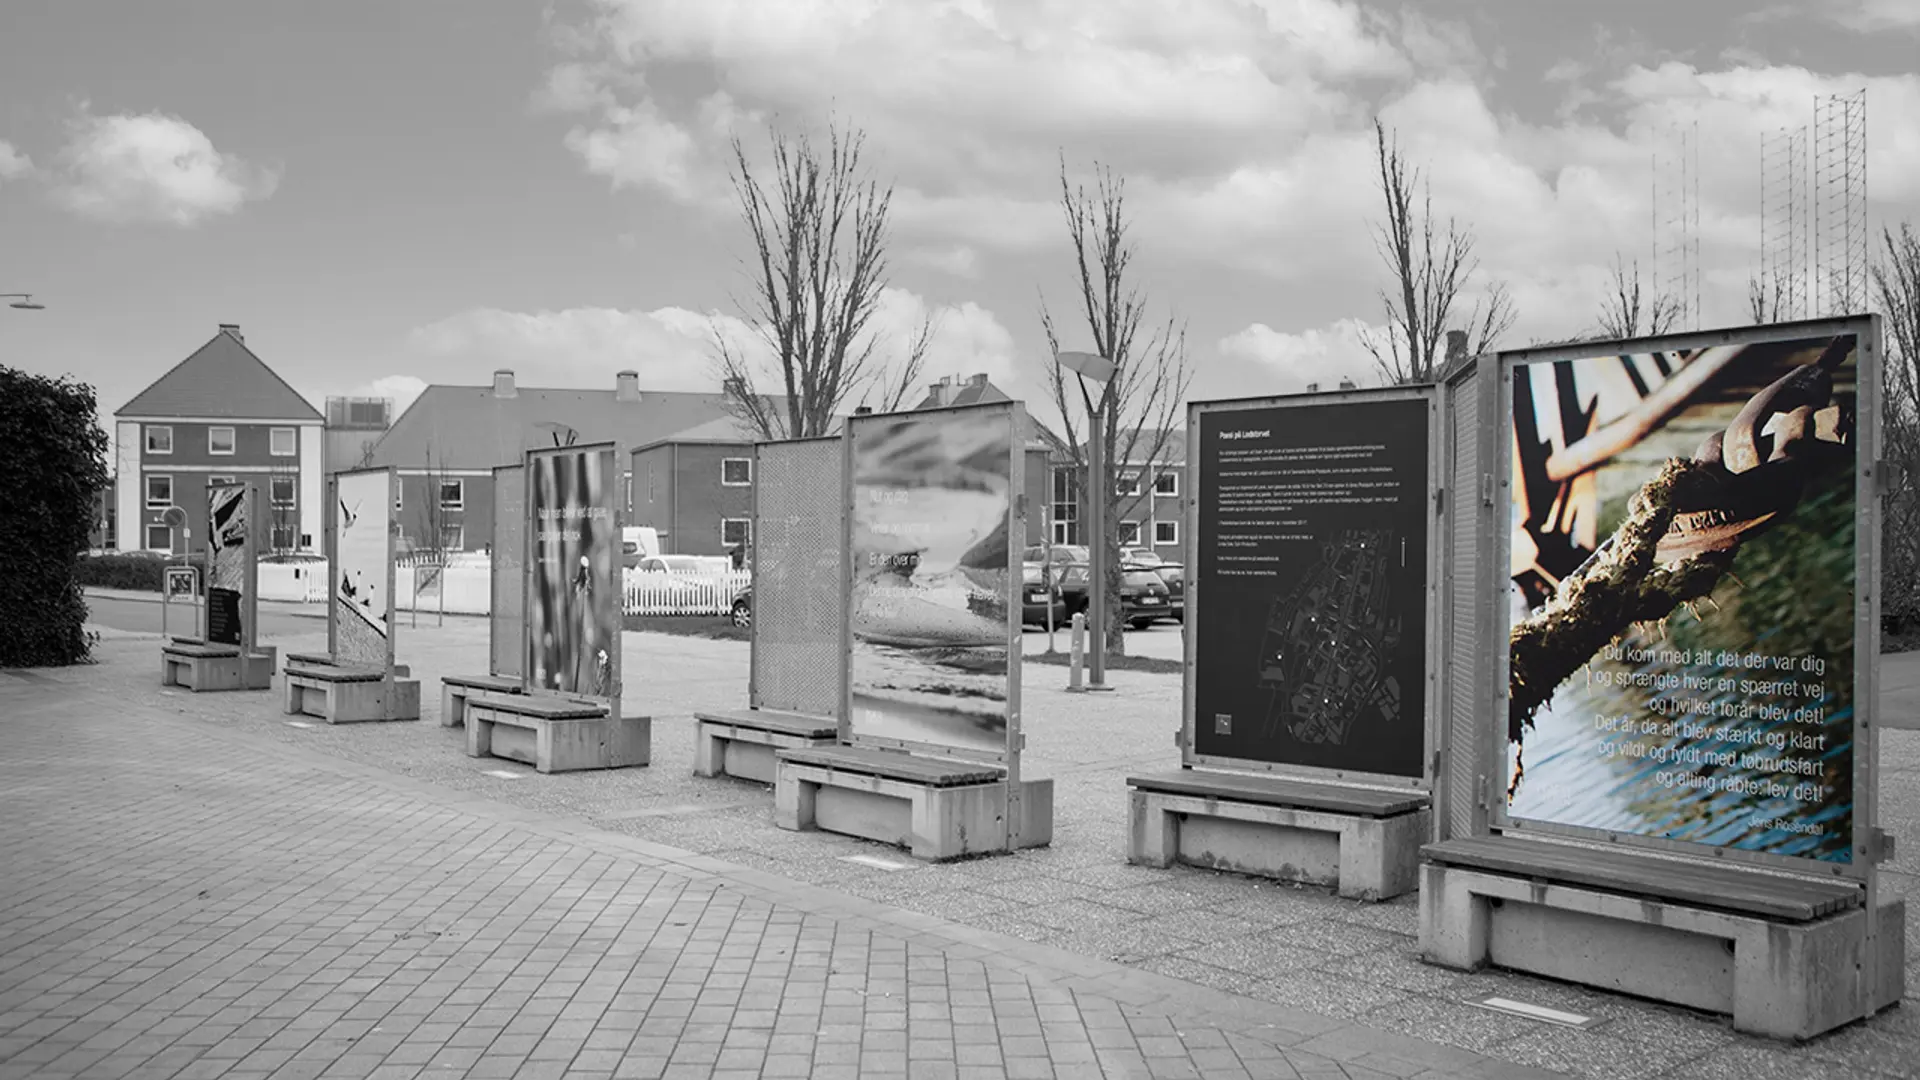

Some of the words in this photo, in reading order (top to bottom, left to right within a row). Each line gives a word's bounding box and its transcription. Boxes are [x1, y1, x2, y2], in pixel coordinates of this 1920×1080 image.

[1604, 645, 1622, 661] Du
[1627, 646, 1655, 663] kom
[1660, 648, 1690, 664] med
[1695, 650, 1712, 666] alt
[1716, 649, 1740, 668] det
[1744, 651, 1768, 669] der
[1772, 655, 1796, 671] var
[1801, 654, 1825, 676] dig
[1596, 671, 1612, 687] og
[1616, 671, 1679, 691] sprængte
[1683, 672, 1714, 691] hver
[1717, 678, 1736, 692] en
[1740, 679, 1799, 697] spærret
[1803, 680, 1825, 702] vej
[1649, 697, 1666, 715] og
[1671, 696, 1716, 716] hvilket
[1720, 700, 1757, 719] forår
[1759, 703, 1790, 721] blev
[1794, 705, 1824, 725] det!
[1595, 714, 1618, 731] Det
[1621, 715, 1637, 735] år,
[1641, 718, 1658, 734] da
[1662, 721, 1680, 737] alt
[1683, 722, 1713, 739] blev
[1715, 727, 1762, 745] stærkt
[1765, 731, 1785, 750] og
[1790, 731, 1825, 751] klart
[1598, 741, 1615, 758] og
[1619, 741, 1646, 758] vildt
[1649, 745, 1666, 764] og
[1671, 744, 1701, 765] fyldt
[1704, 750, 1736, 767] med
[1741, 752, 1824, 777] tøbrudsfart
[1656, 771, 1673, 788] og
[1677, 771, 1716, 793] alting
[1767, 779, 1790, 798] lev
[1793, 783, 1823, 803] det!
[1748, 815, 1773, 829] Jens
[1775, 817, 1824, 836] Rosendal
